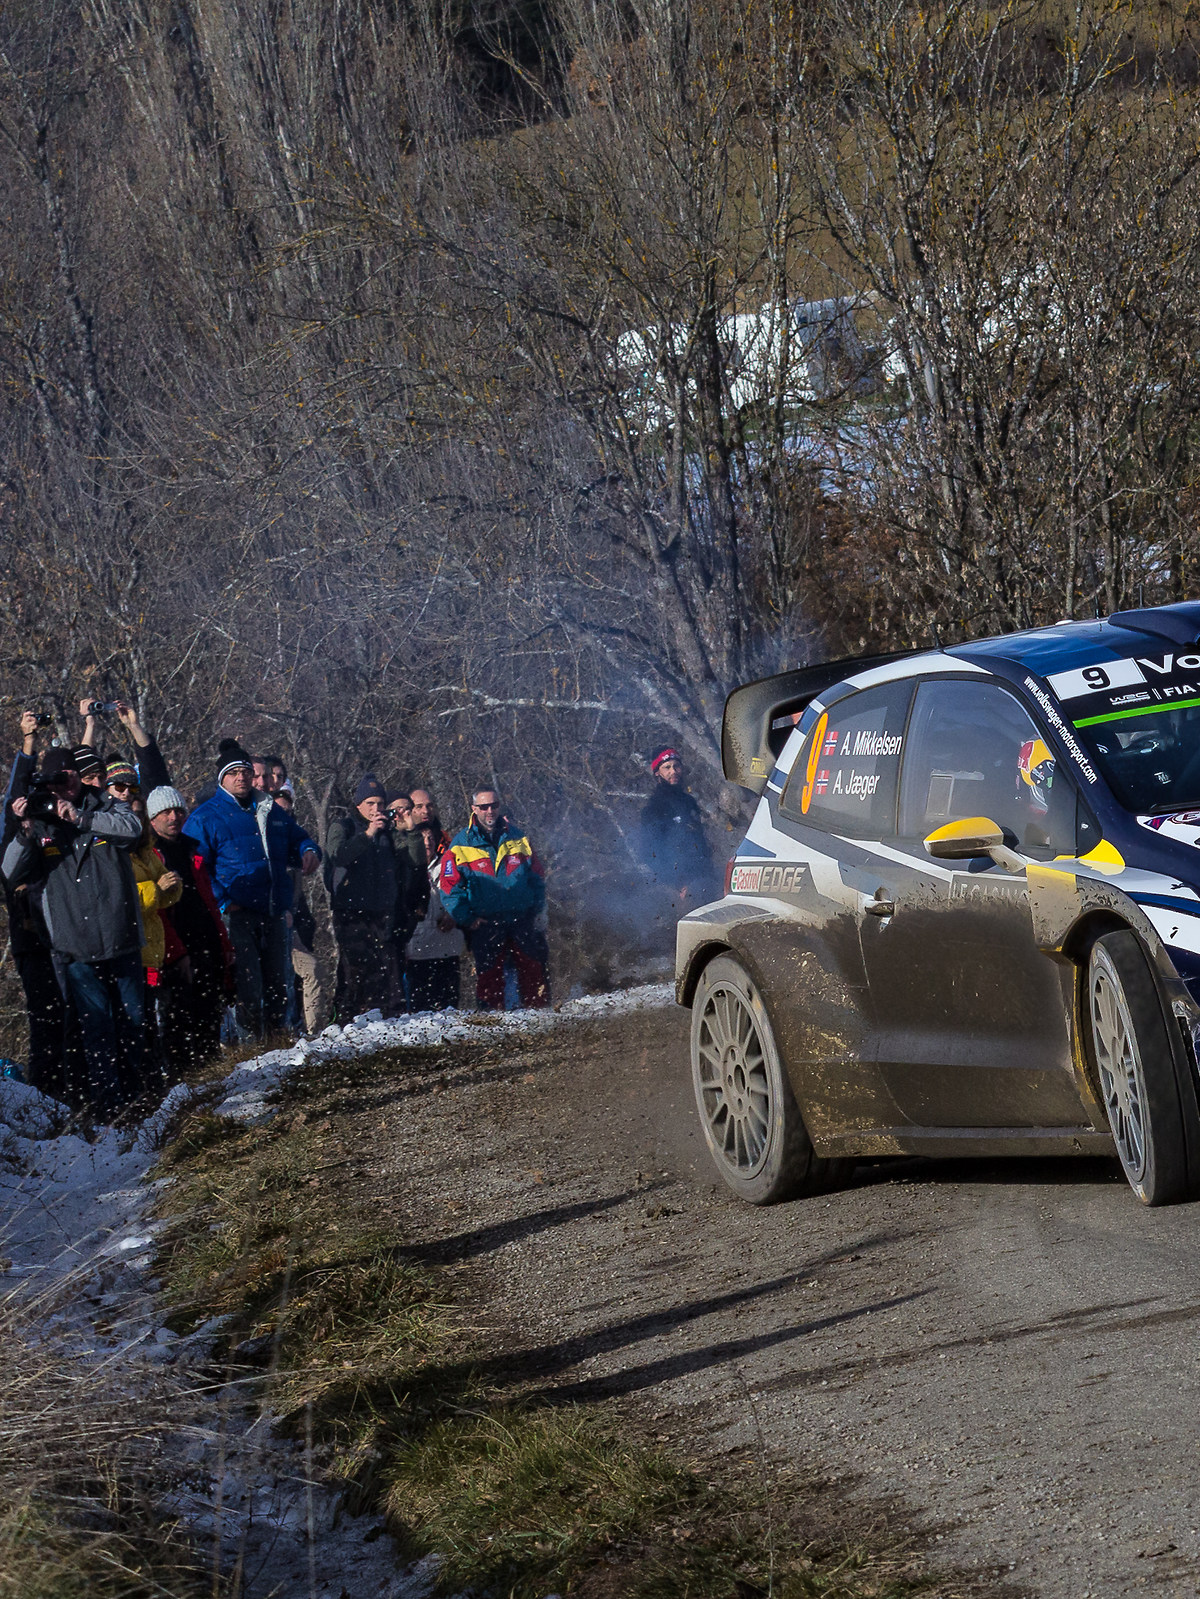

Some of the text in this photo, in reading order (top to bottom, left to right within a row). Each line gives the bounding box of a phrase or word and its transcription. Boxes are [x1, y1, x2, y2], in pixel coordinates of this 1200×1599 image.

[1082, 667, 1111, 690] 9
[1163, 684, 1197, 697] FIA
[839, 730, 903, 756] A. Mikkelsen
[1023, 676, 1098, 785] www.volkswagen-motorsport.com
[801, 712, 828, 815] 9
[832, 769, 880, 801] A. Jæger
[736, 866, 806, 892] Castrol EDGE
